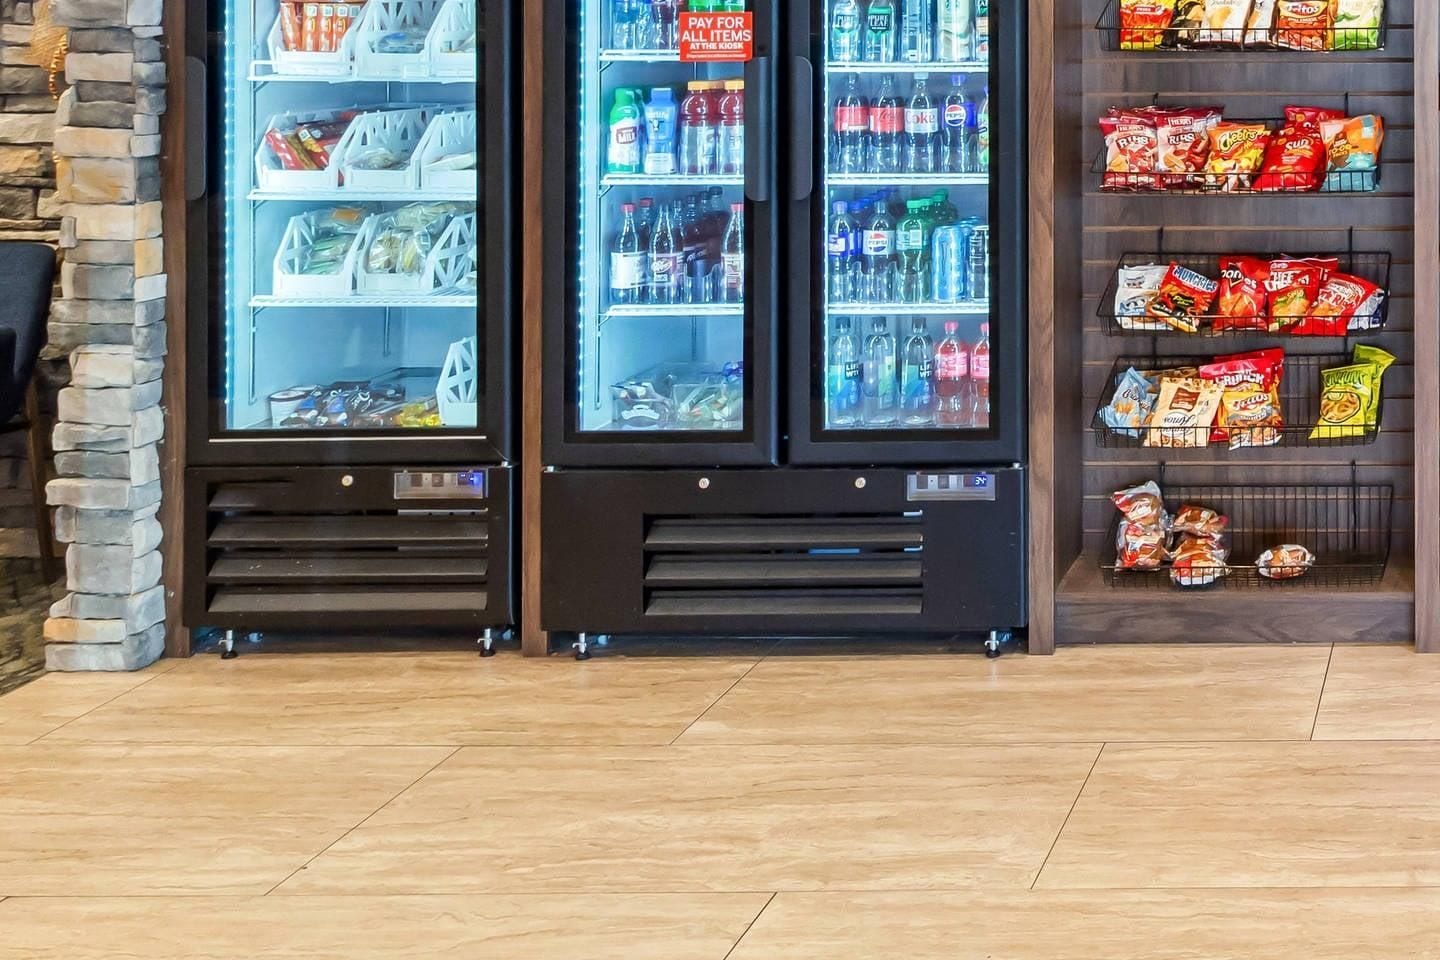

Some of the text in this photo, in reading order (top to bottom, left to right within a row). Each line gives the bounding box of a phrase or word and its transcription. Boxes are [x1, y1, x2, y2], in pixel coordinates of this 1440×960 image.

[688, 16, 745, 29] PAY FOR
[681, 29, 752, 42] ALL ITEMS
[1172, 265, 1218, 292] MUNCHIES
